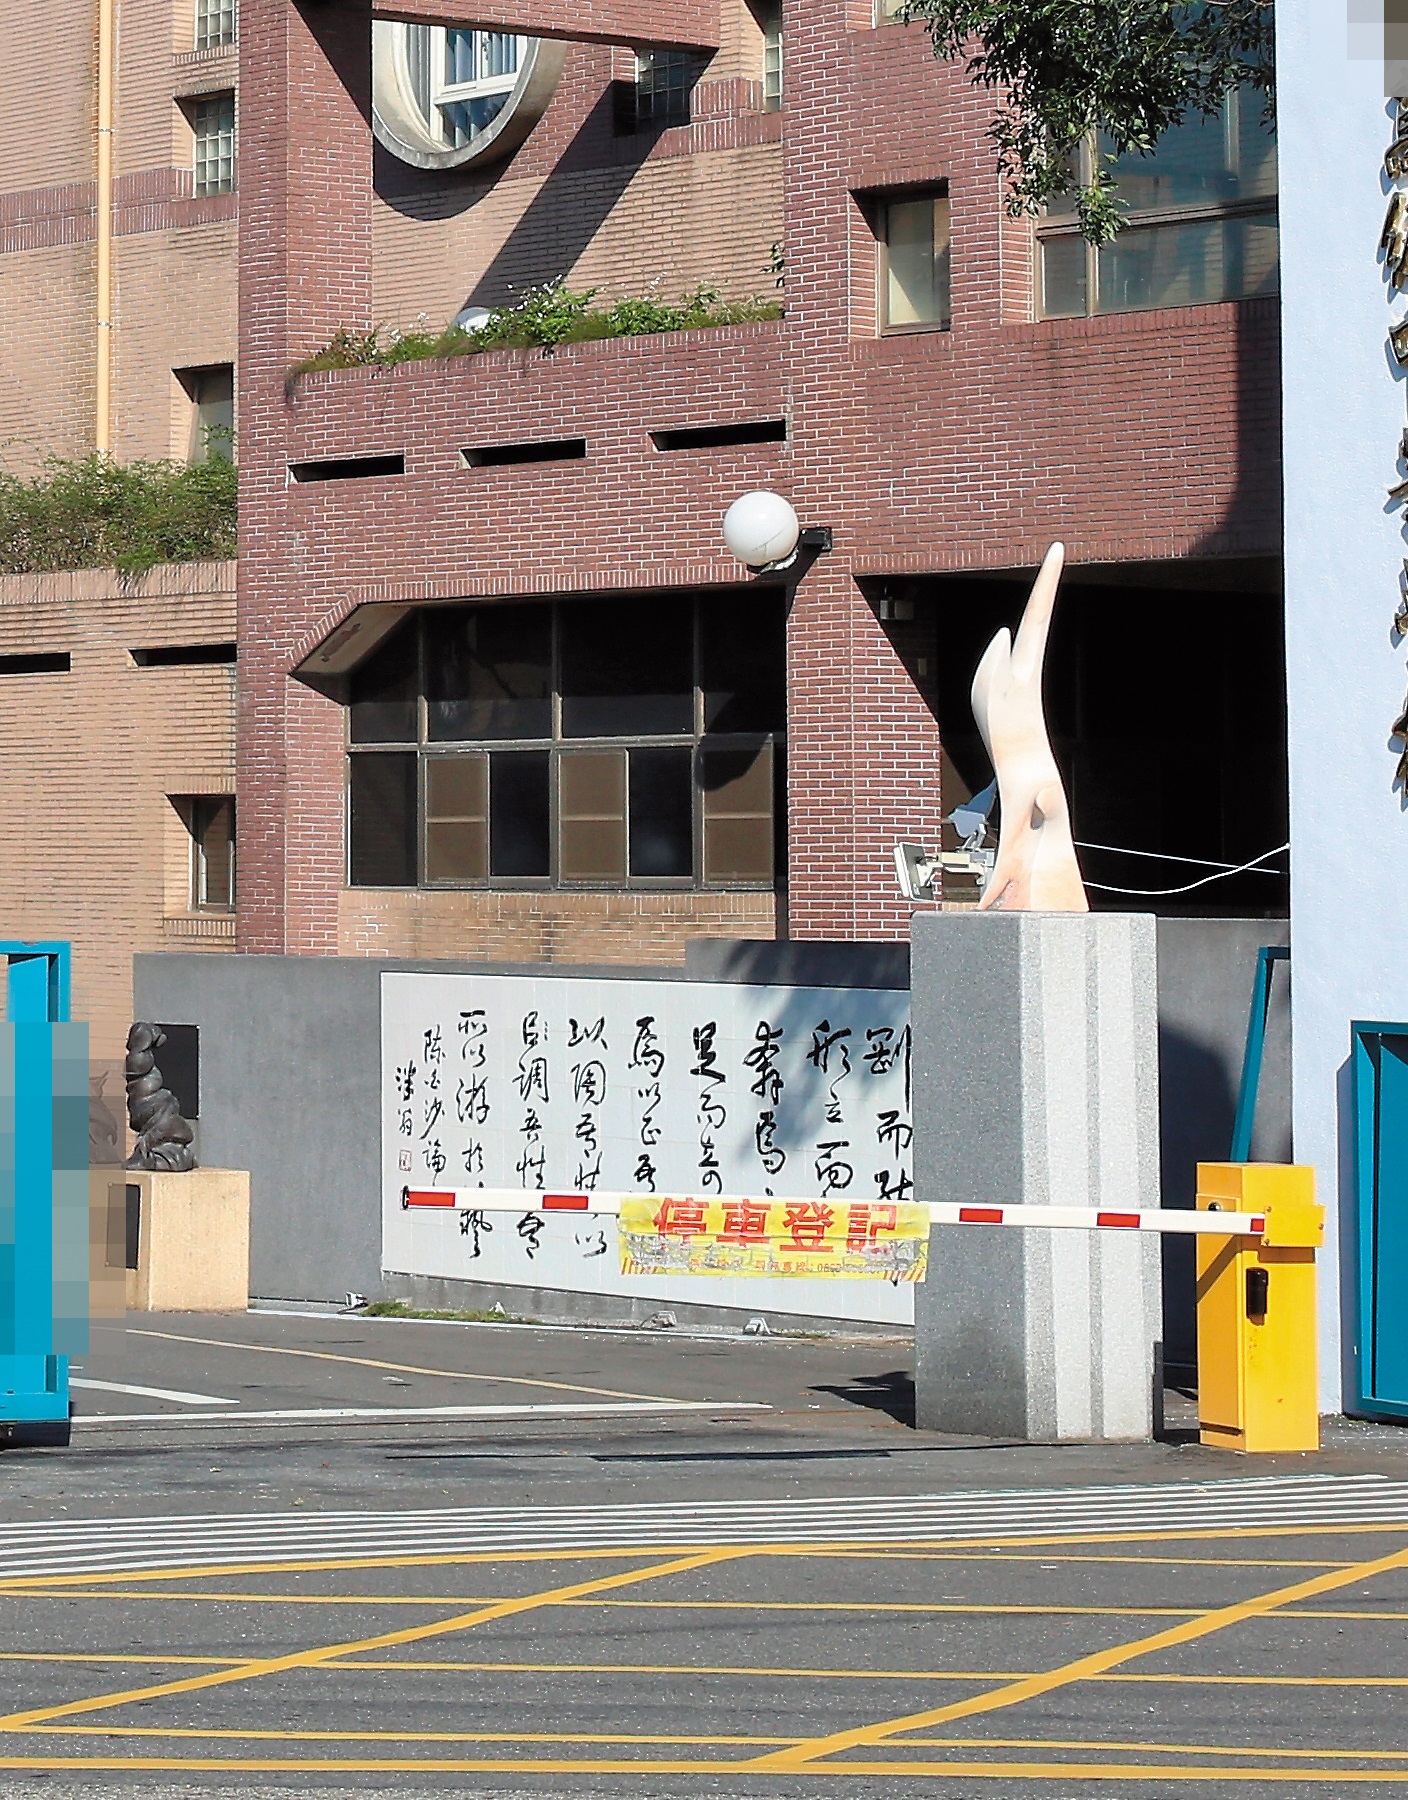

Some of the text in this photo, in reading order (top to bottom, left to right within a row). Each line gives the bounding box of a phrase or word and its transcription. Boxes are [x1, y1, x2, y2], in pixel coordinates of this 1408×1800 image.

[806, 1019, 853, 1197] 形立而
[653, 1197, 897, 1254] 停車登記
